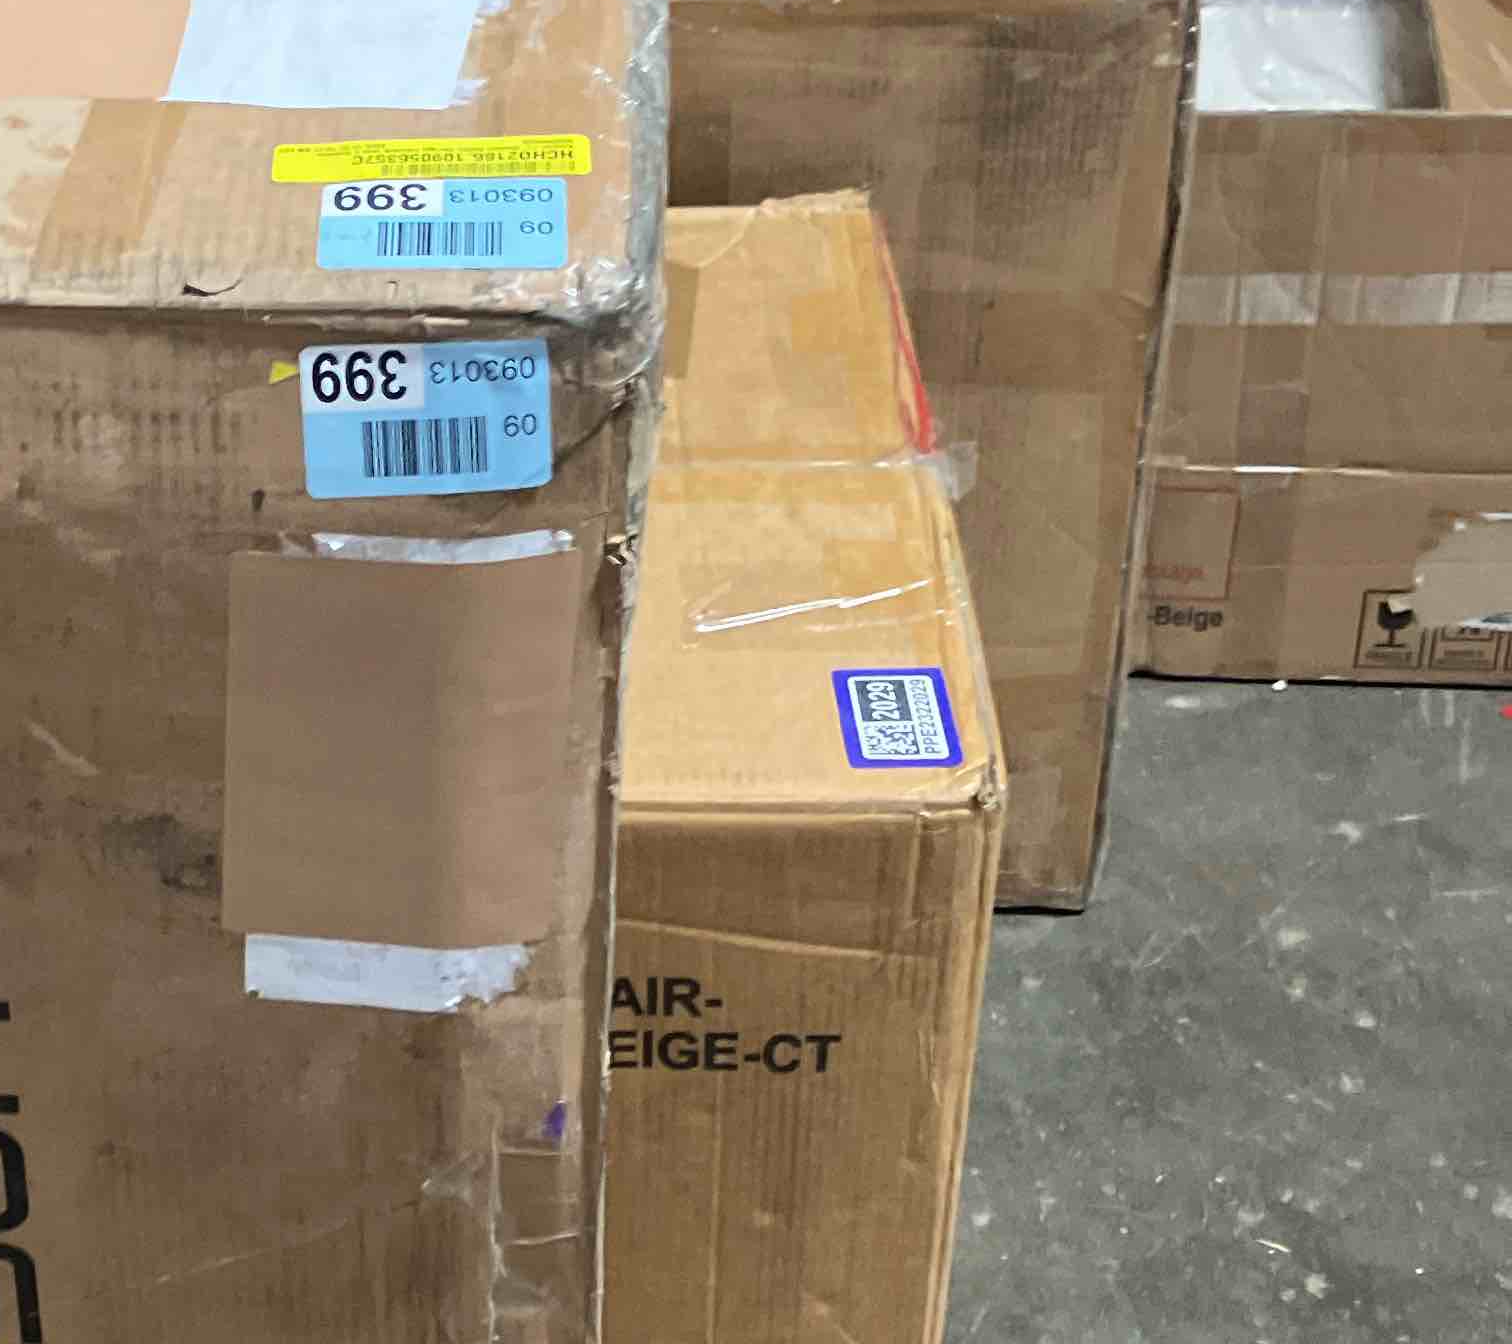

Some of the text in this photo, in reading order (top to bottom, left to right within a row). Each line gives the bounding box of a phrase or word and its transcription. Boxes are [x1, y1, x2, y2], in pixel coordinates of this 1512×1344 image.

[333, 182, 554, 212] 399 093013
[519, 220, 554, 236] 09
[311, 349, 537, 404] 399 093013
[503, 413, 538, 438] 09
[865, 679, 901, 721] 2029
